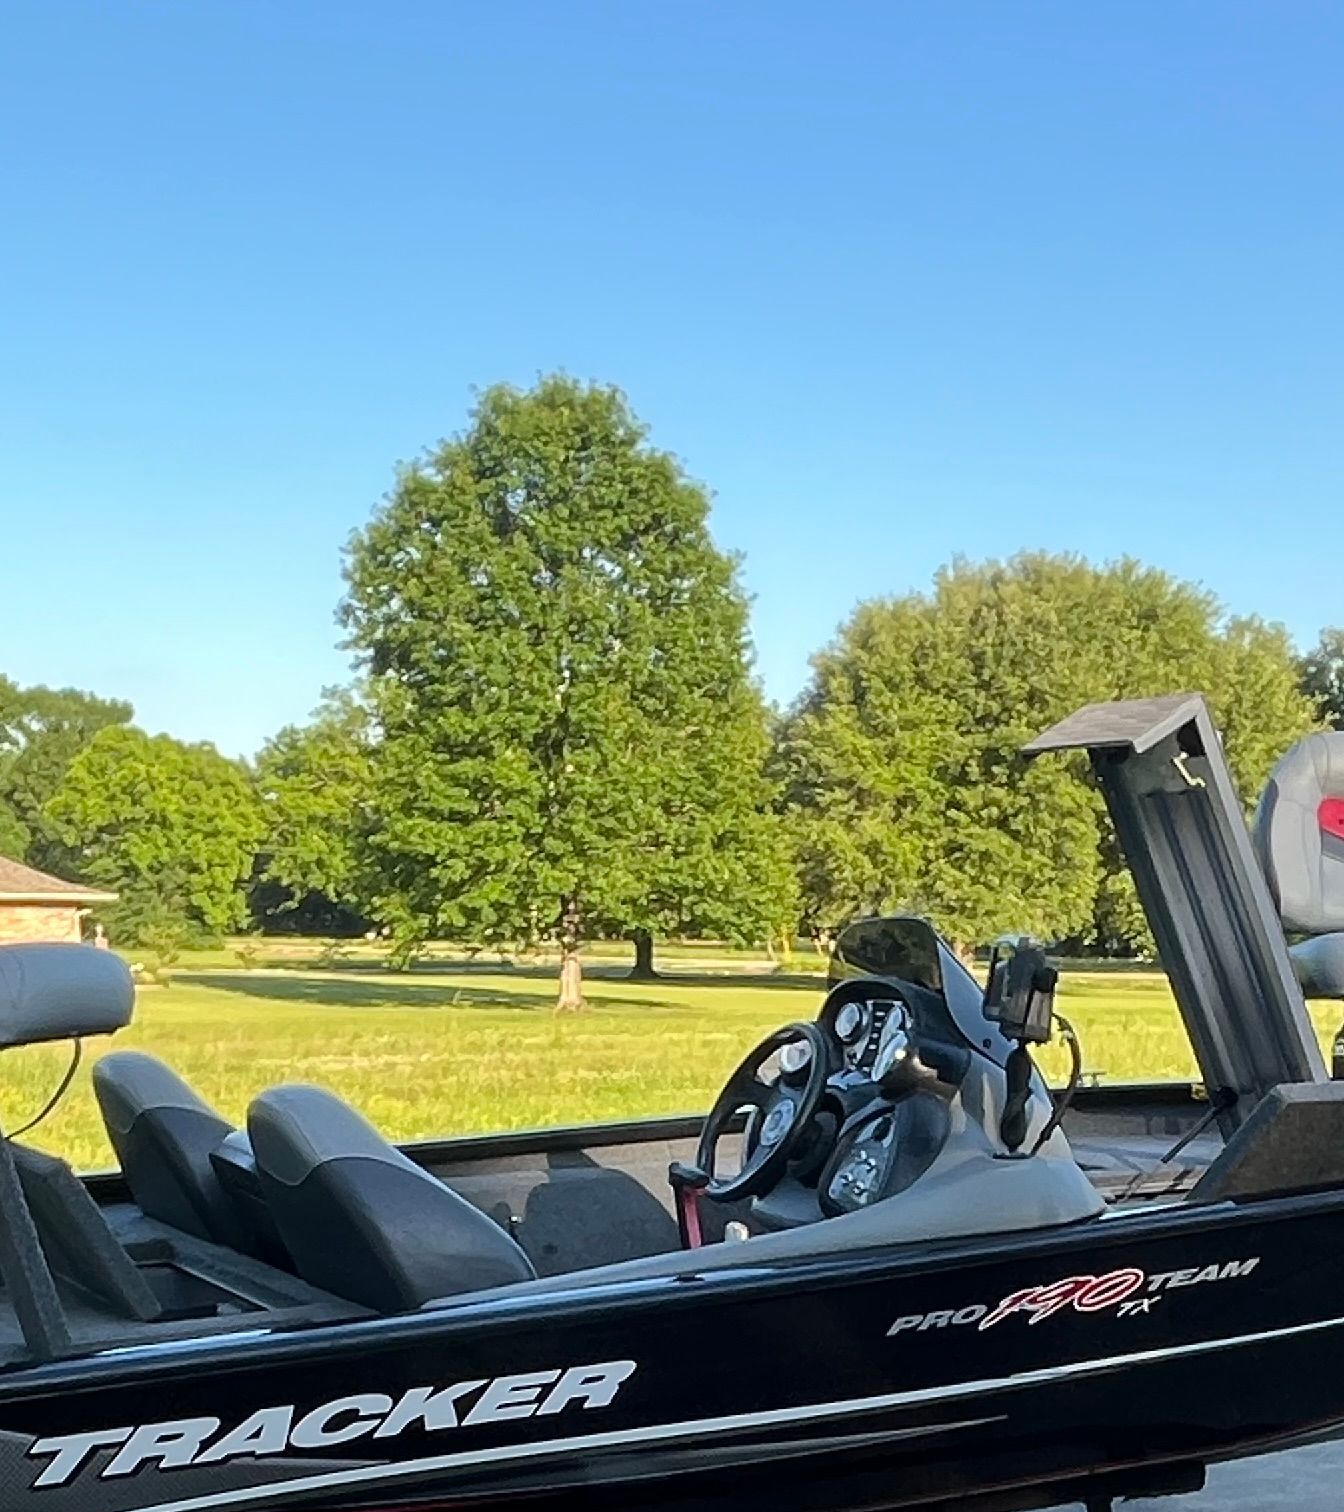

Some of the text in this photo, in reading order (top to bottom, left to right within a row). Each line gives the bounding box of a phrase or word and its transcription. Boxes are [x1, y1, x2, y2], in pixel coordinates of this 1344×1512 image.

[885, 1256, 1261, 1337] PRO 190 TEAM
[1117, 1295, 1162, 1318] TX
[30, 1360, 638, 1488] TRACKER
